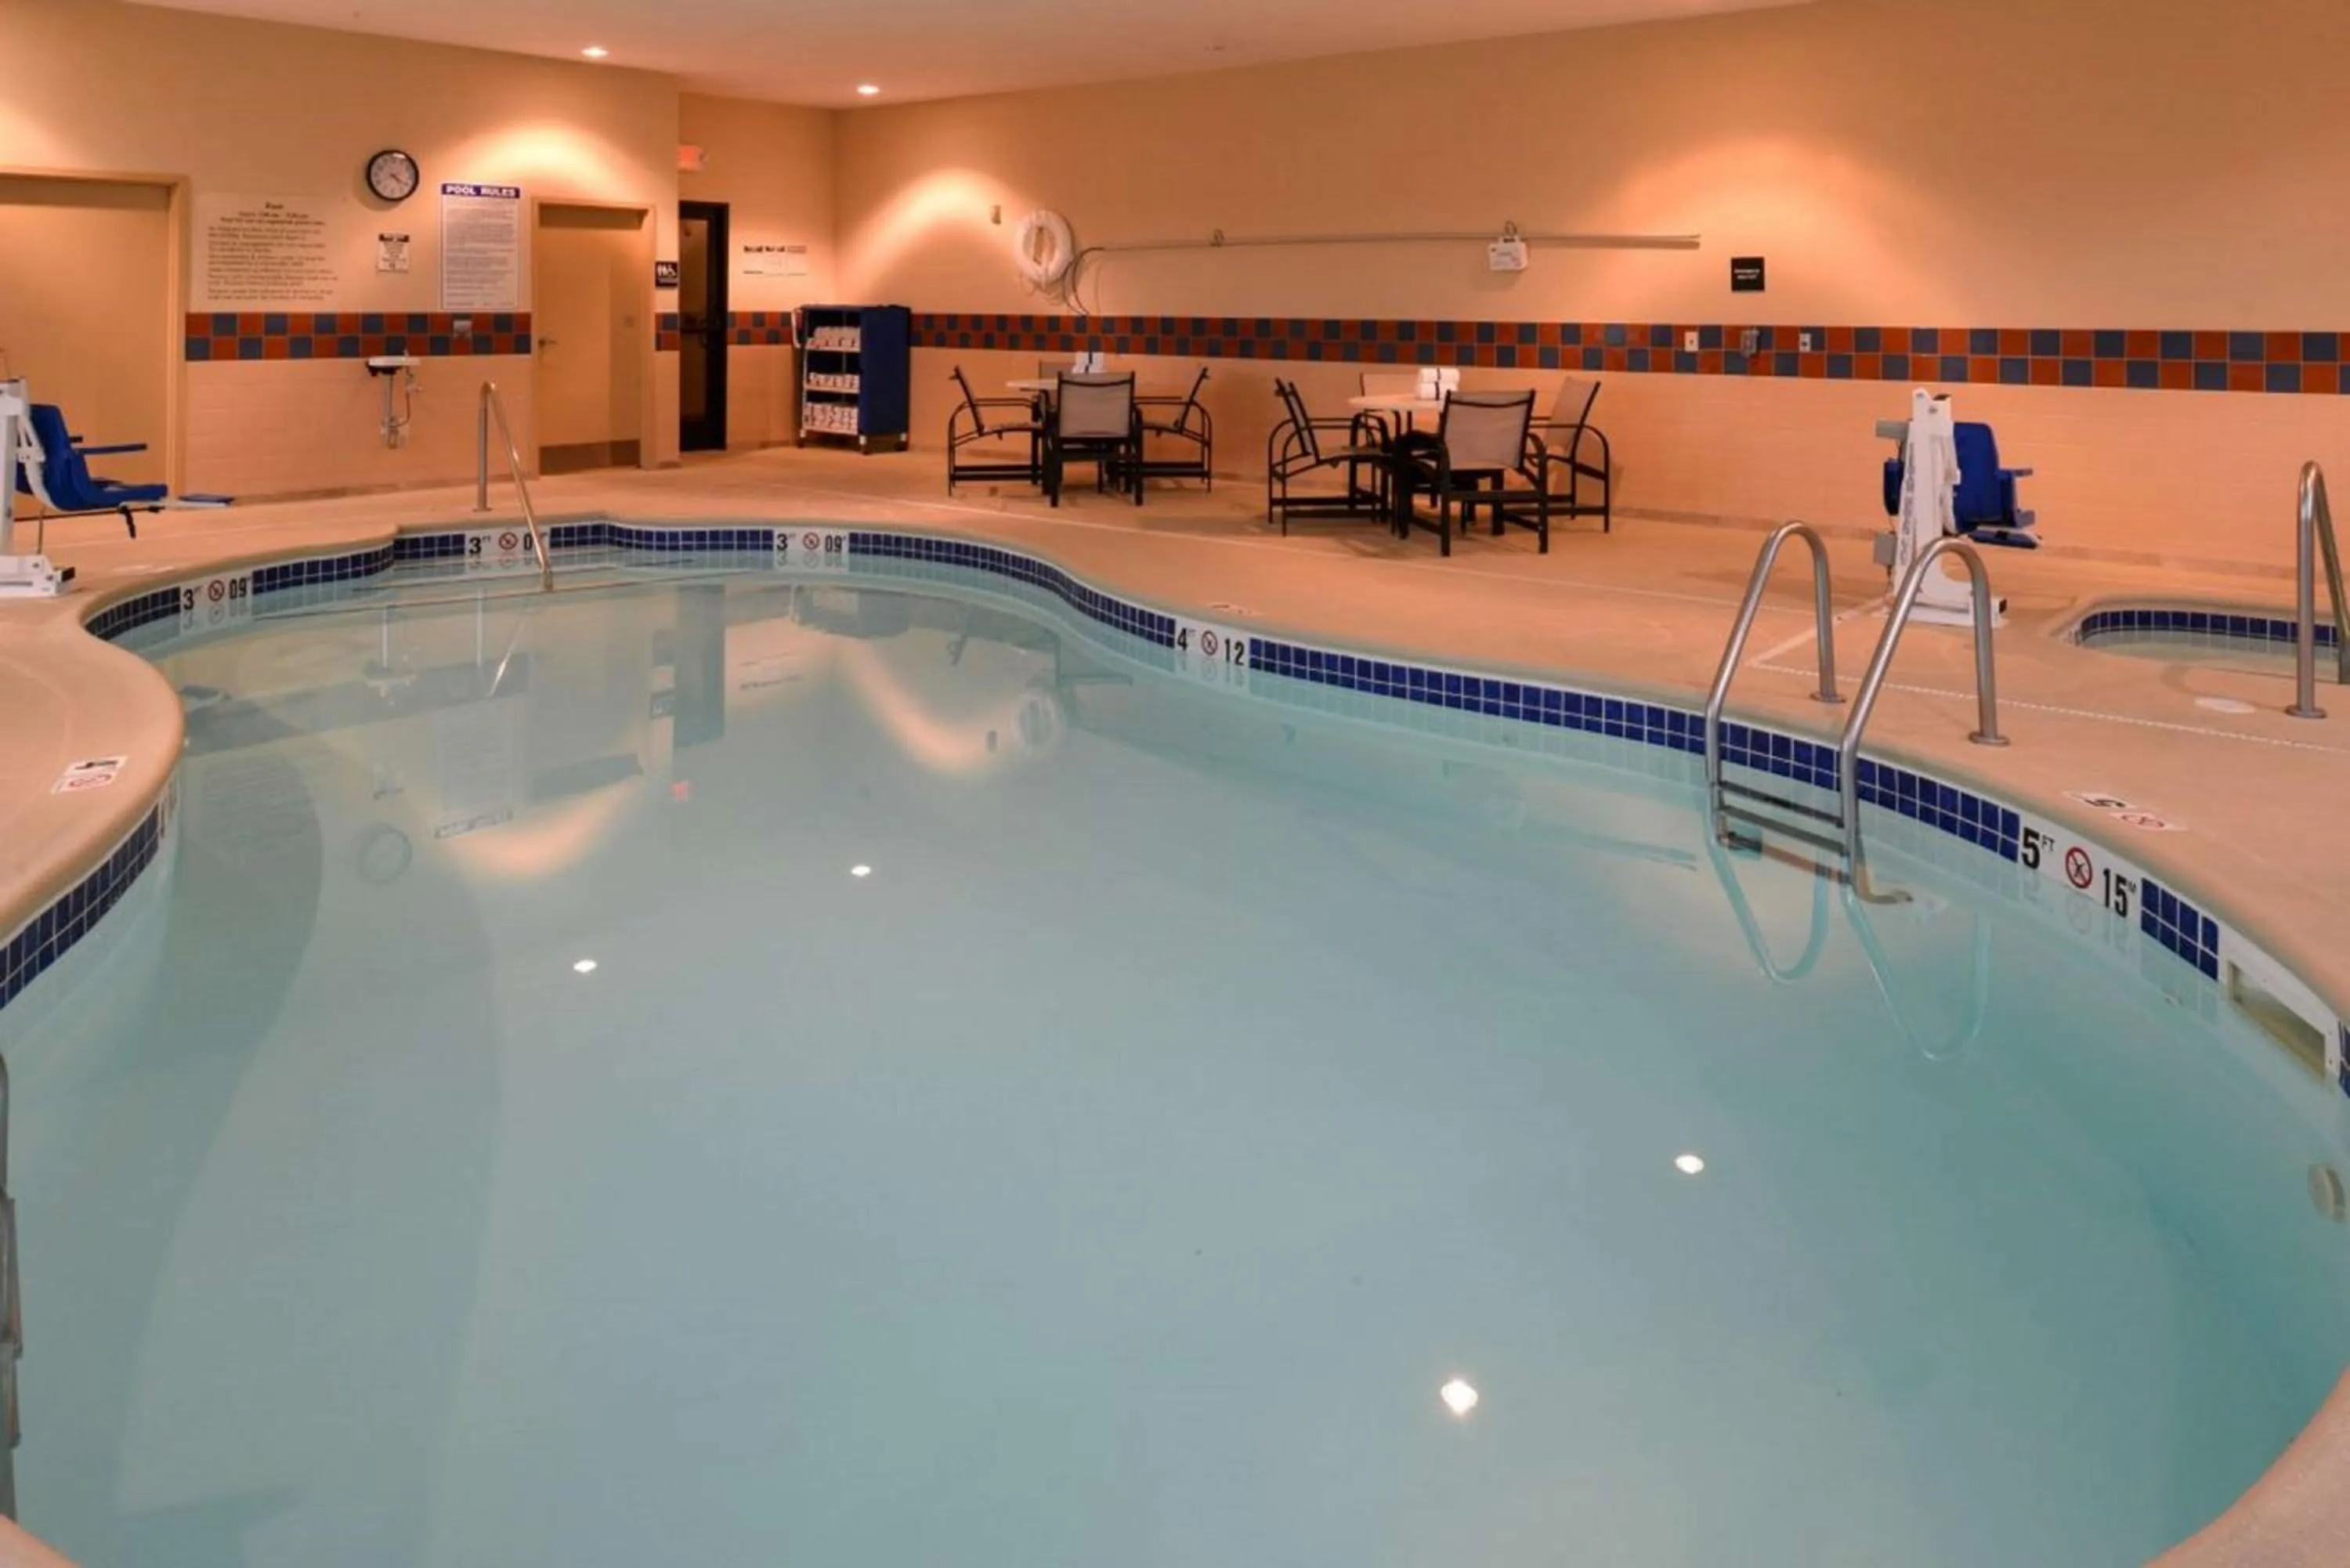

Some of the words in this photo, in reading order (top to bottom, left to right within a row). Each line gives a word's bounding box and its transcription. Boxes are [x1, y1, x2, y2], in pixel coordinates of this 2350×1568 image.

[446, 185, 477, 196] POOL
[481, 187, 516, 197] RULES
[469, 537, 482, 554] 3
[777, 533, 788, 551] 3
[825, 534, 842, 553] 09
[183, 588, 194, 610] 3
[230, 577, 247, 600] 09
[1177, 628, 1188, 652] 4
[1225, 637, 1245, 666] 12
[2022, 826, 2041, 869] 5
[2102, 868, 2128, 918] 15
